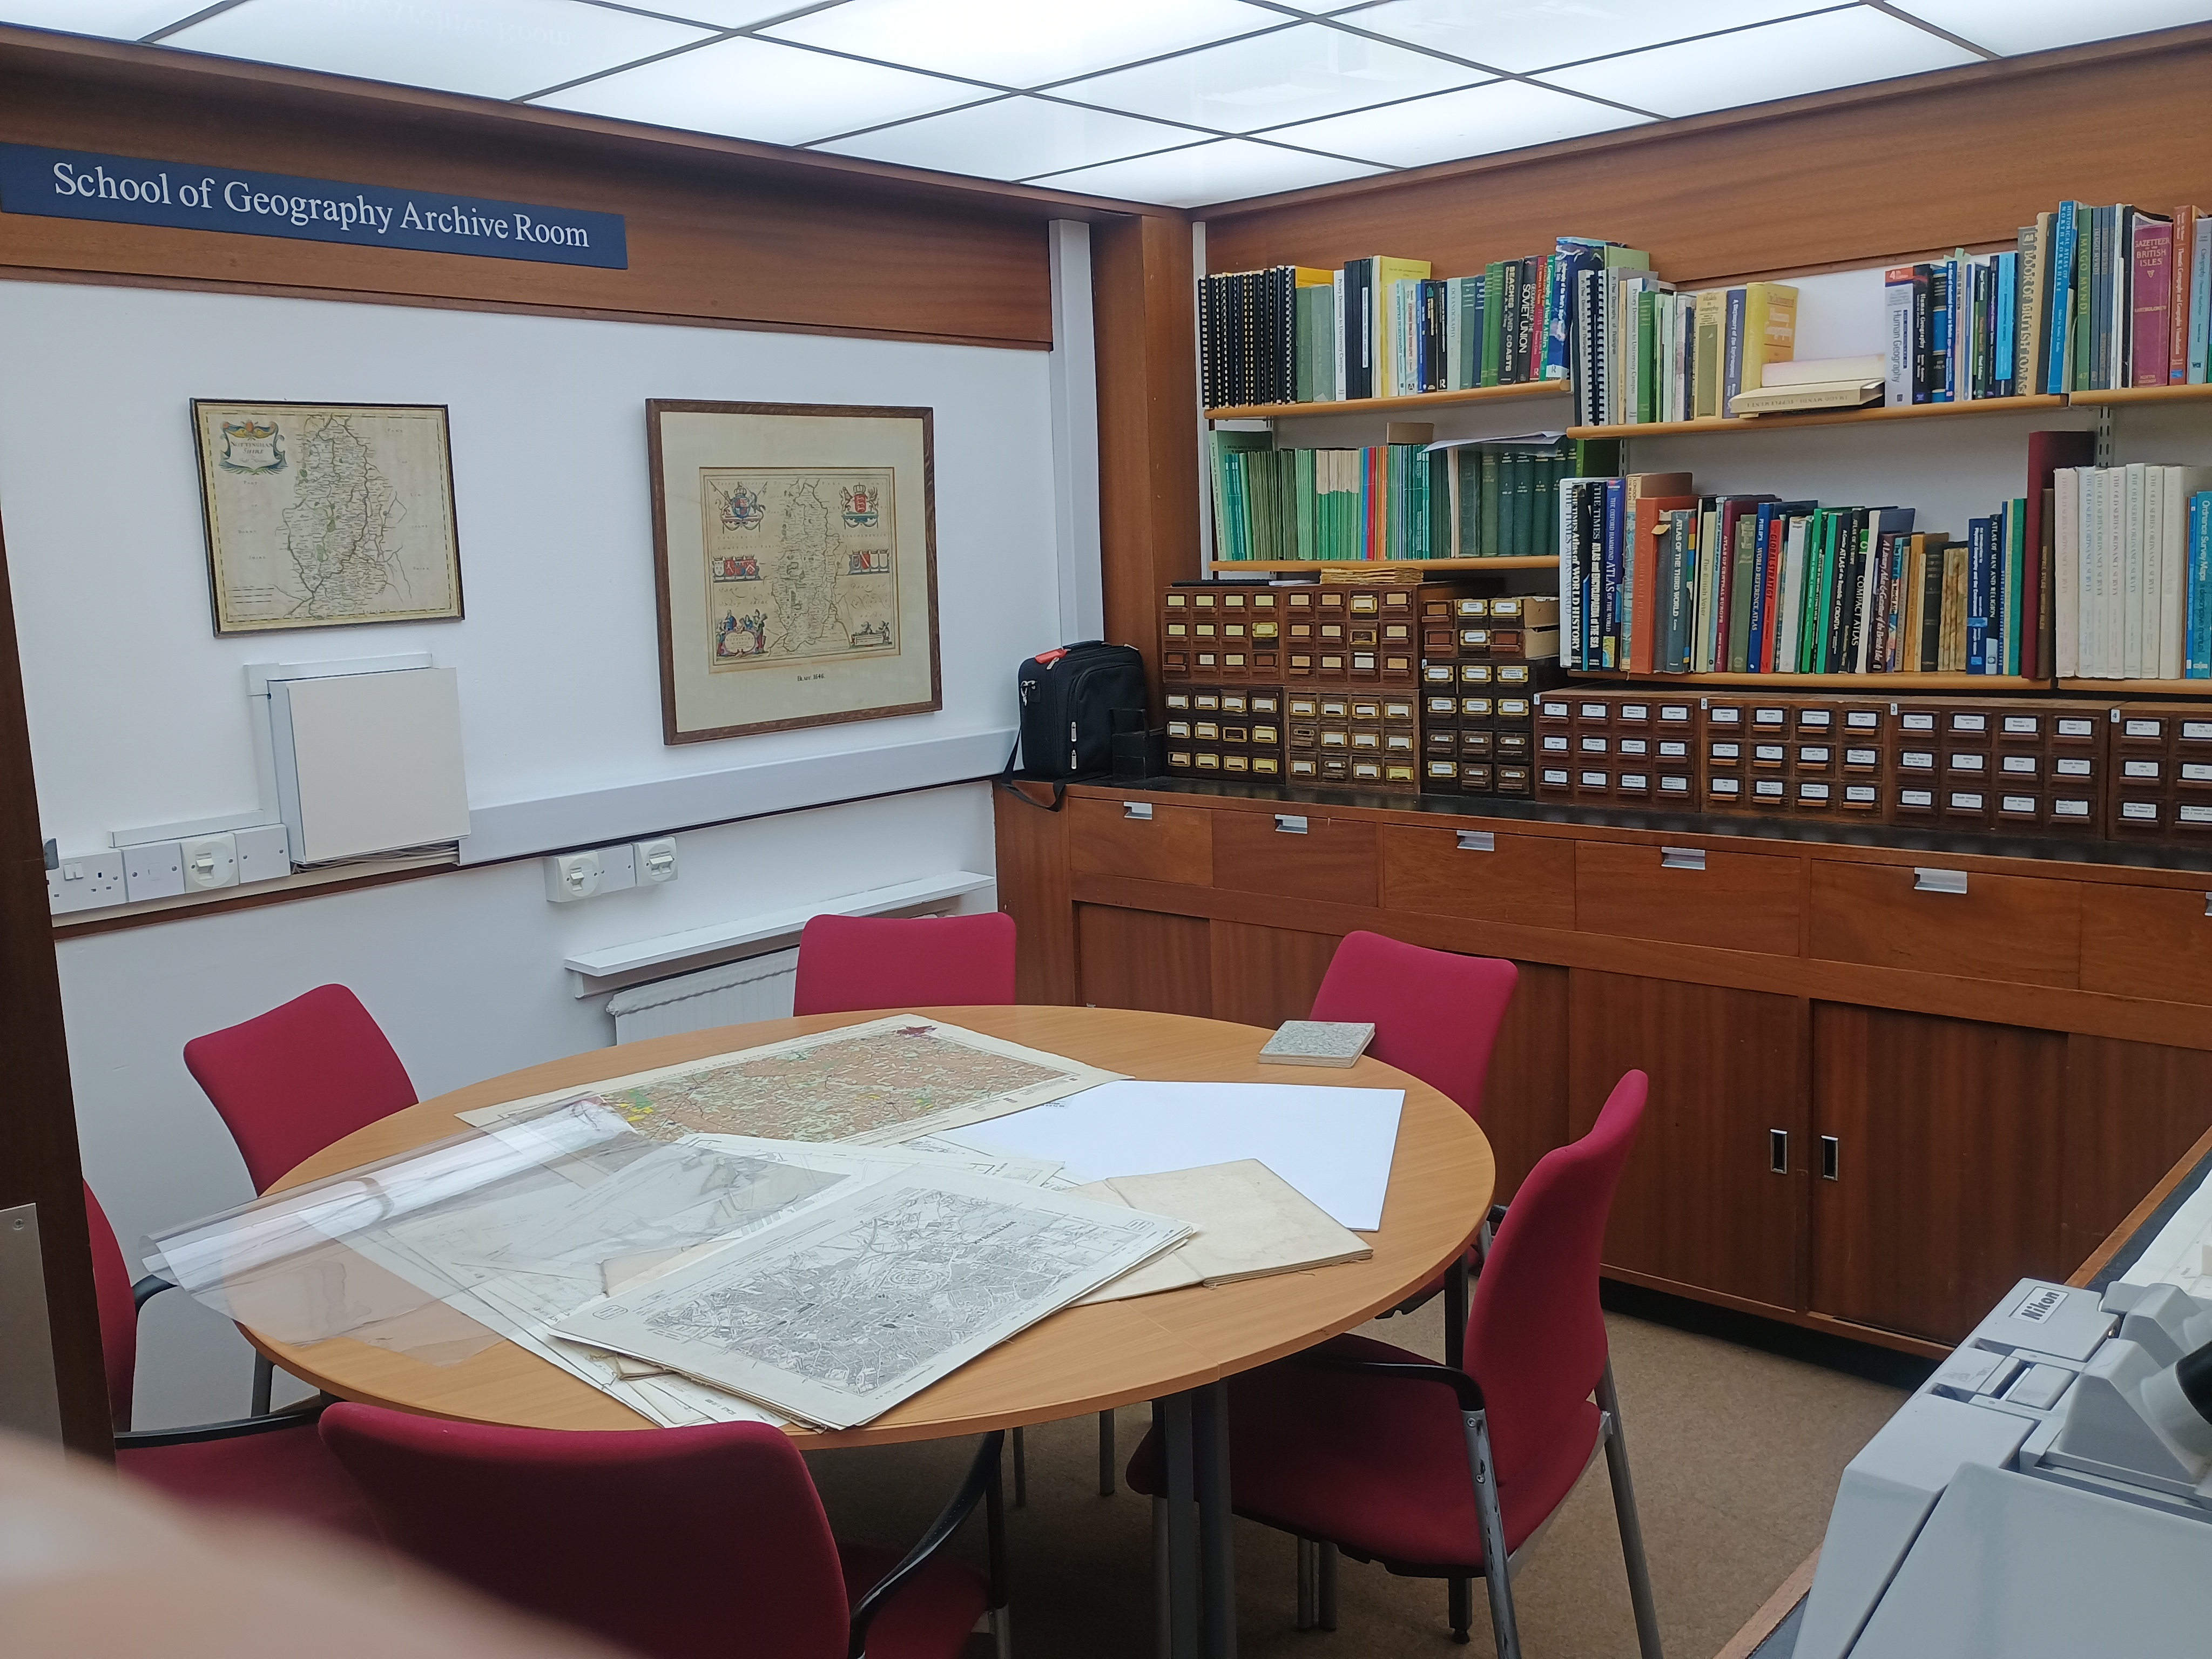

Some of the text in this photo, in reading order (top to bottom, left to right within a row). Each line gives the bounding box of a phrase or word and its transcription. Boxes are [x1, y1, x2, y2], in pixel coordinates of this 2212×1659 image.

[53, 162, 591, 249] School of Geography Archive Room
[2063, 206, 2072, 245] HISTORICAL
[2134, 237, 2171, 248] GAZETTEER
[2136, 249, 2167, 259] BRITISH
[2062, 270, 2068, 279] OF
[2079, 233, 2088, 315] IMAGO MVNDI
[2140, 258, 2163, 267] ISLES
[1545, 265, 1553, 298] Geography
[1519, 284, 1531, 353] SOVIET UNION
[2017, 250, 2035, 395] BOOK OF BRITISH TOWNS
[1918, 316, 1926, 349] Geography
[1891, 310, 1903, 383] Human Geography
[2111, 475, 2120, 489] THE
[2129, 474, 2137, 487] THE
[1593, 485, 1602, 507] THE
[2111, 490, 2120, 506] OLD
[2129, 488, 2137, 503] OLD
[1564, 512, 1573, 545] TIMES
[1592, 508, 1601, 540] TIMES
[1675, 518, 1683, 541] ATLAS
[2201, 500, 2211, 535] Ordnance
[1572, 532, 1580, 555] Atlas
[1591, 542, 1601, 561] ATLAS
[1675, 541, 1683, 552] OF
[1990, 542, 1997, 551] OF
[2111, 531, 2120, 568] ORDNANCE
[2129, 528, 2137, 565] ORDNANCE
[2199, 535, 2209, 560] Survey
[1572, 555, 1580, 565] of
[1591, 562, 1600, 572] and
[1721, 556, 1727, 565] OF
[1755, 548, 1763, 572] WORLD
[1765, 534, 1777, 600] GLOBAL STRATEGY
[1838, 548, 1847, 568] ATLAS
[1605, 561, 1616, 592] ATLAS
[1719, 566, 1727, 596] CENTRAL
[1880, 570, 1889, 585] Atlas
[2198, 561, 2208, 581] Maps
[1571, 566, 1580, 605] WORLD
[1701, 573, 1709, 596] British
[1752, 572, 1762, 610] REFERENCE
[1606, 593, 1612, 602] OF
[1673, 591, 1681, 617] WORLD
[2196, 589, 2207, 625] descriptive
[1751, 611, 1759, 631] ATLAS
[1833, 606, 1842, 630] CROATIA
[1851, 575, 1865, 646] COMPACT ATLAS
[1571, 606, 1580, 651] HISTORY
[1590, 625, 1599, 636] THE
[2197, 626, 2205, 652] manual
[1589, 637, 1599, 649] SEA
[2021, 1292, 2060, 1320] Nikon
